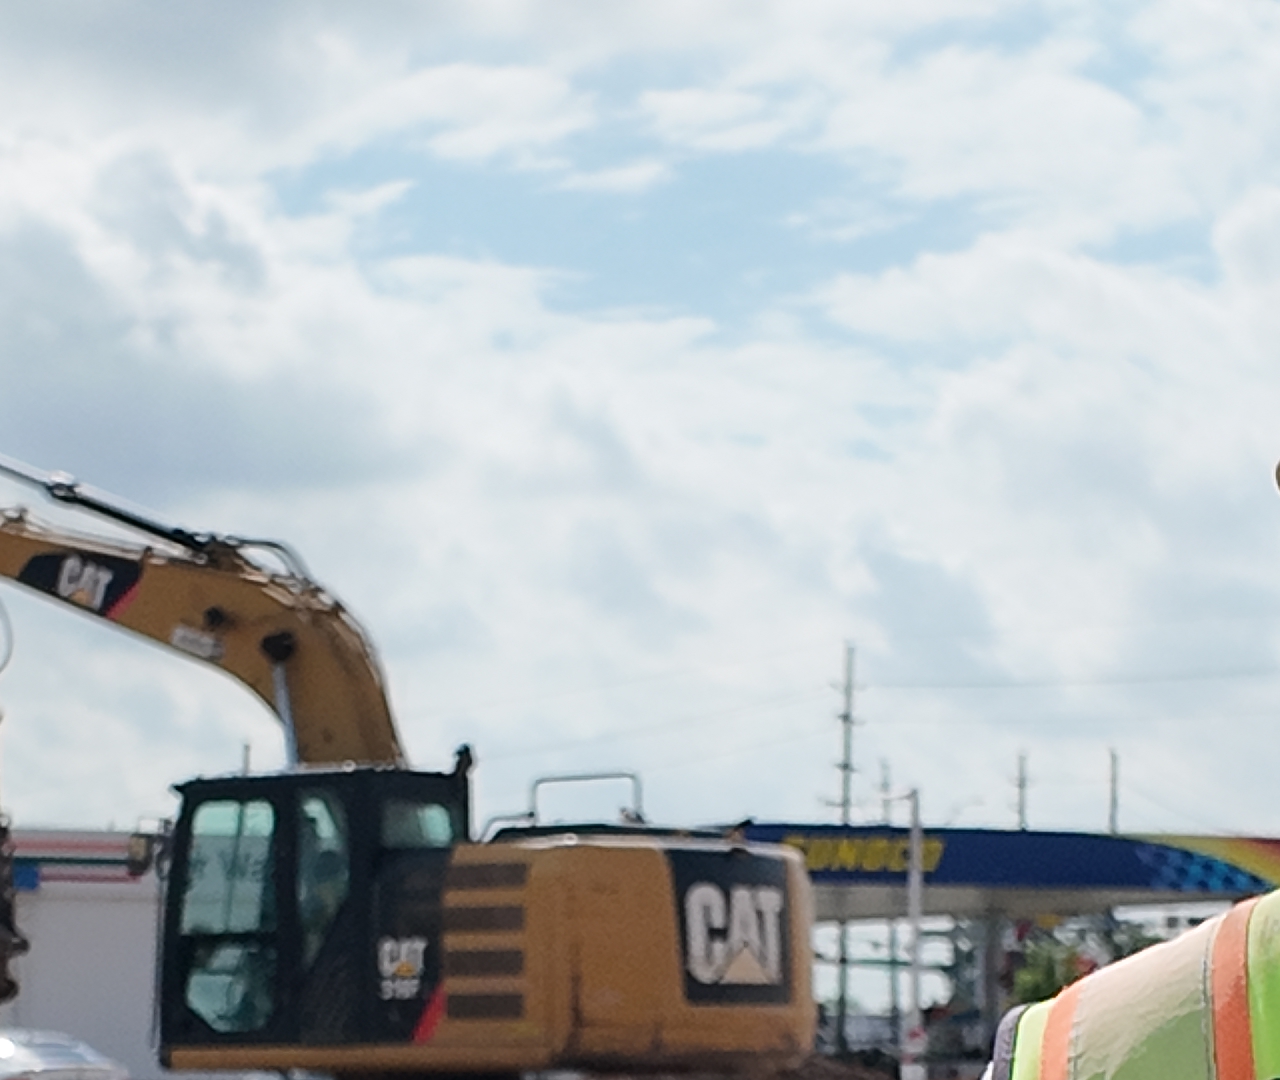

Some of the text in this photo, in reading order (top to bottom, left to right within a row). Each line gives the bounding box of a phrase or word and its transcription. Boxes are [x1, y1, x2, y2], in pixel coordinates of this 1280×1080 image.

[59, 556, 114, 610] CAT
[378, 936, 427, 978] CAT
[685, 882, 782, 985] CAT
